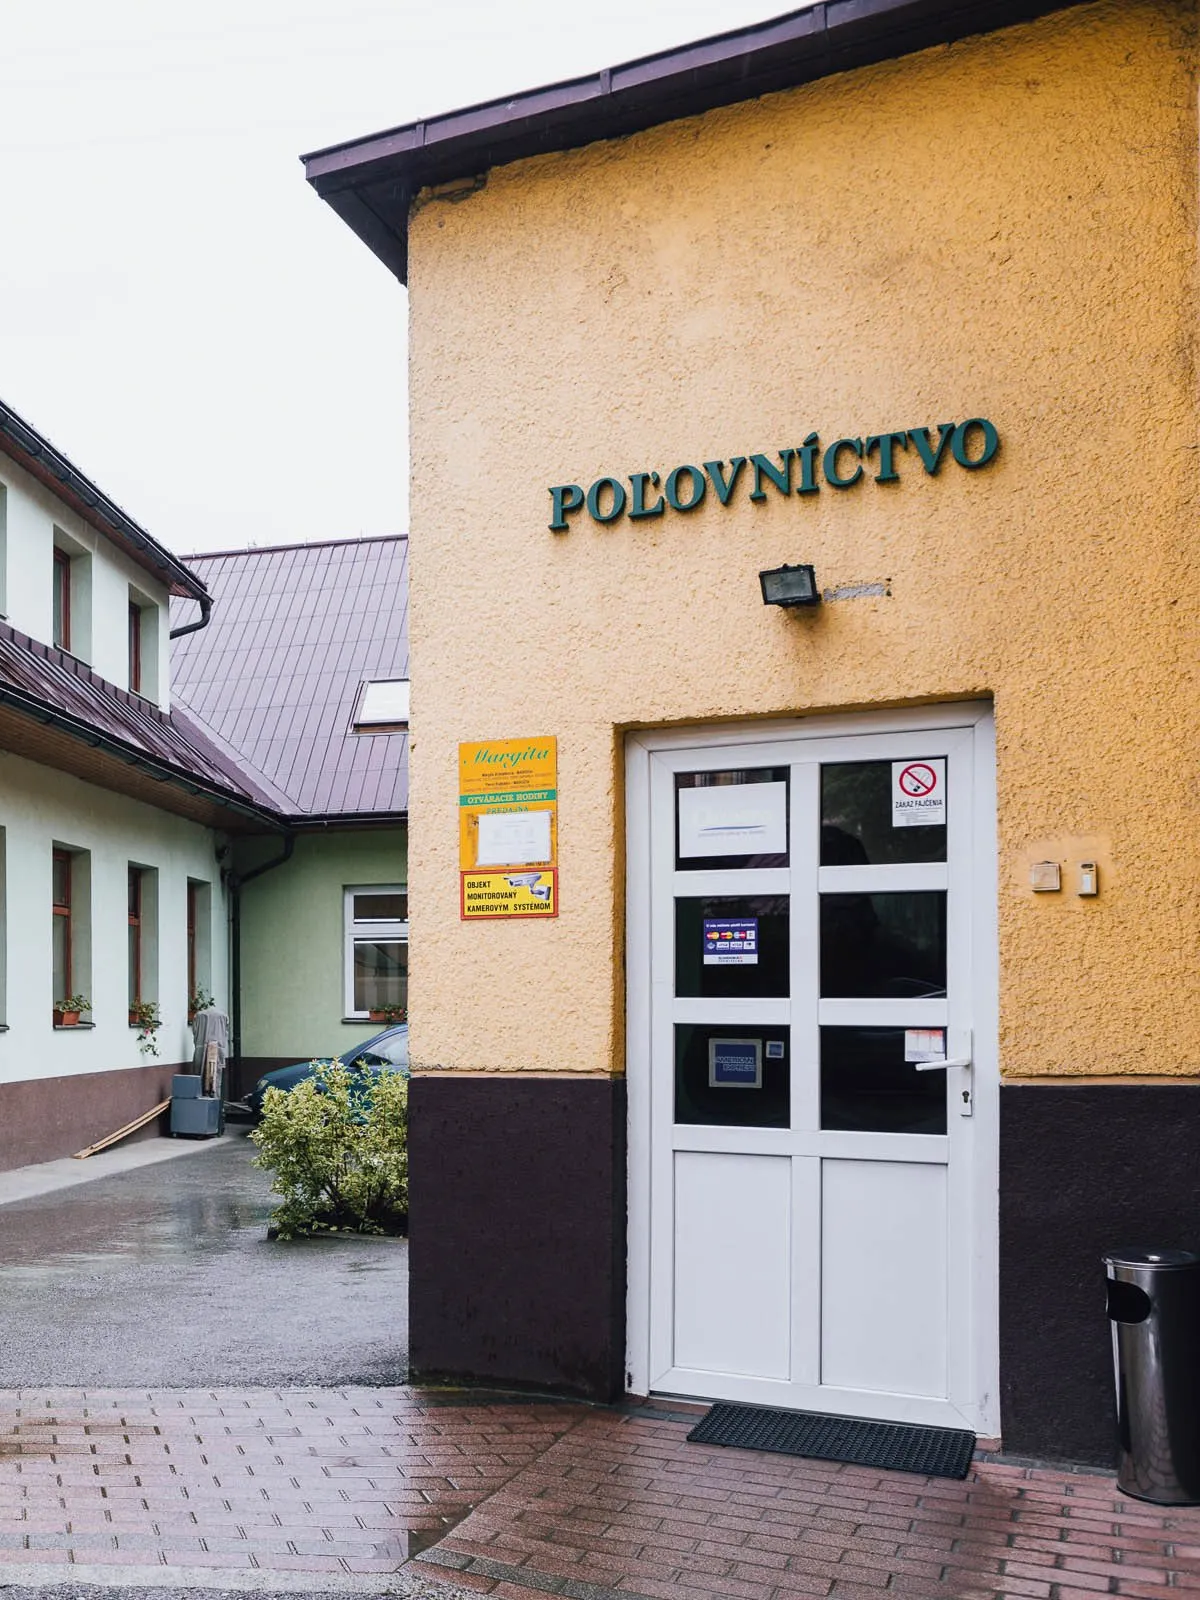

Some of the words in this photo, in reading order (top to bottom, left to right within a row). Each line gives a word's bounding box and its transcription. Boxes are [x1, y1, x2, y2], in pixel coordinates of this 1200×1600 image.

[547, 417, 999, 531] POĽOVNÍCTVO
[464, 746, 549, 769] Margita
[467, 881, 491, 889] OBJEKT
[467, 890, 517, 900] MONITOROVANÝ
[467, 903, 509, 912] KAMEROVÝM
[513, 902, 551, 911] SYSTÉMOM
